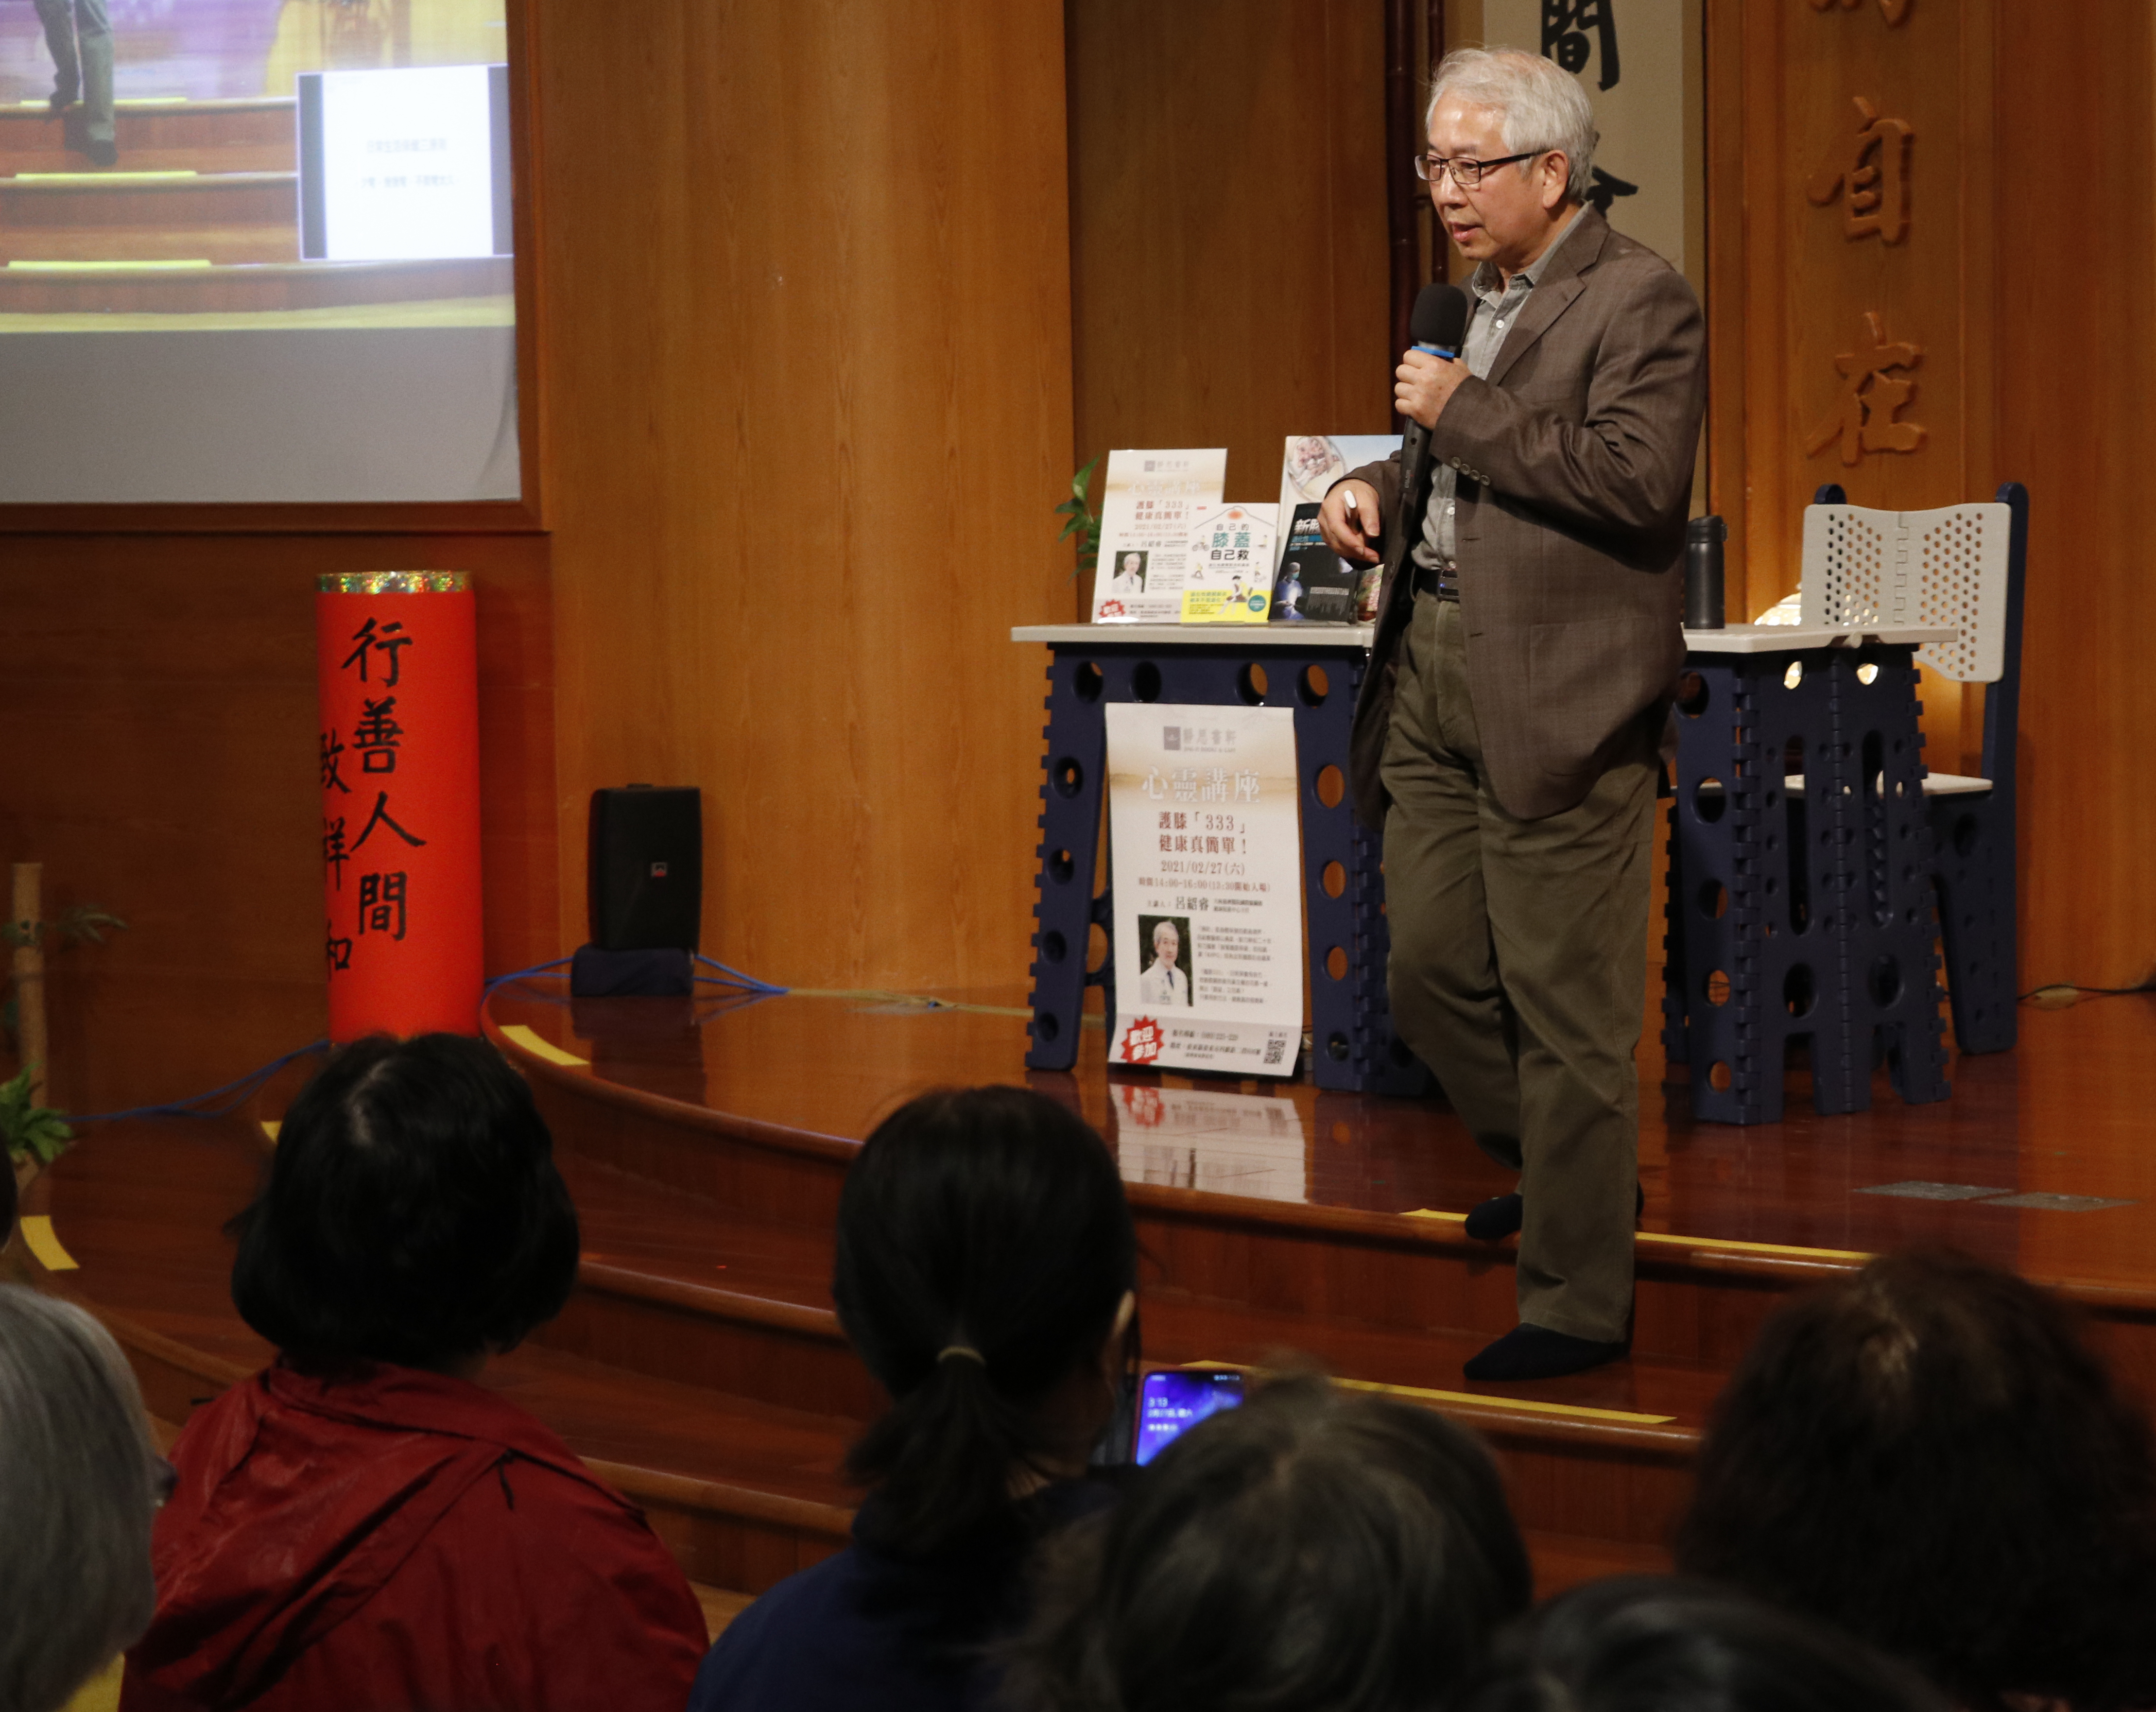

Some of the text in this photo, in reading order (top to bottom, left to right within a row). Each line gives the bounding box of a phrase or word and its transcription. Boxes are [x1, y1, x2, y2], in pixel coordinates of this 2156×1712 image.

[1805, 0, 1928, 467] 自在
[1216, 523, 1249, 531] 自己的
[1211, 532, 1251, 548] 膝蓋
[1211, 549, 1250, 561] 自己救
[341, 616, 427, 942] 行善人間
[1142, 766, 1261, 803] 心靈講座
[1158, 811, 1246, 833] 護膝「333」
[1161, 860, 1245, 876] 2021/02/27(六)
